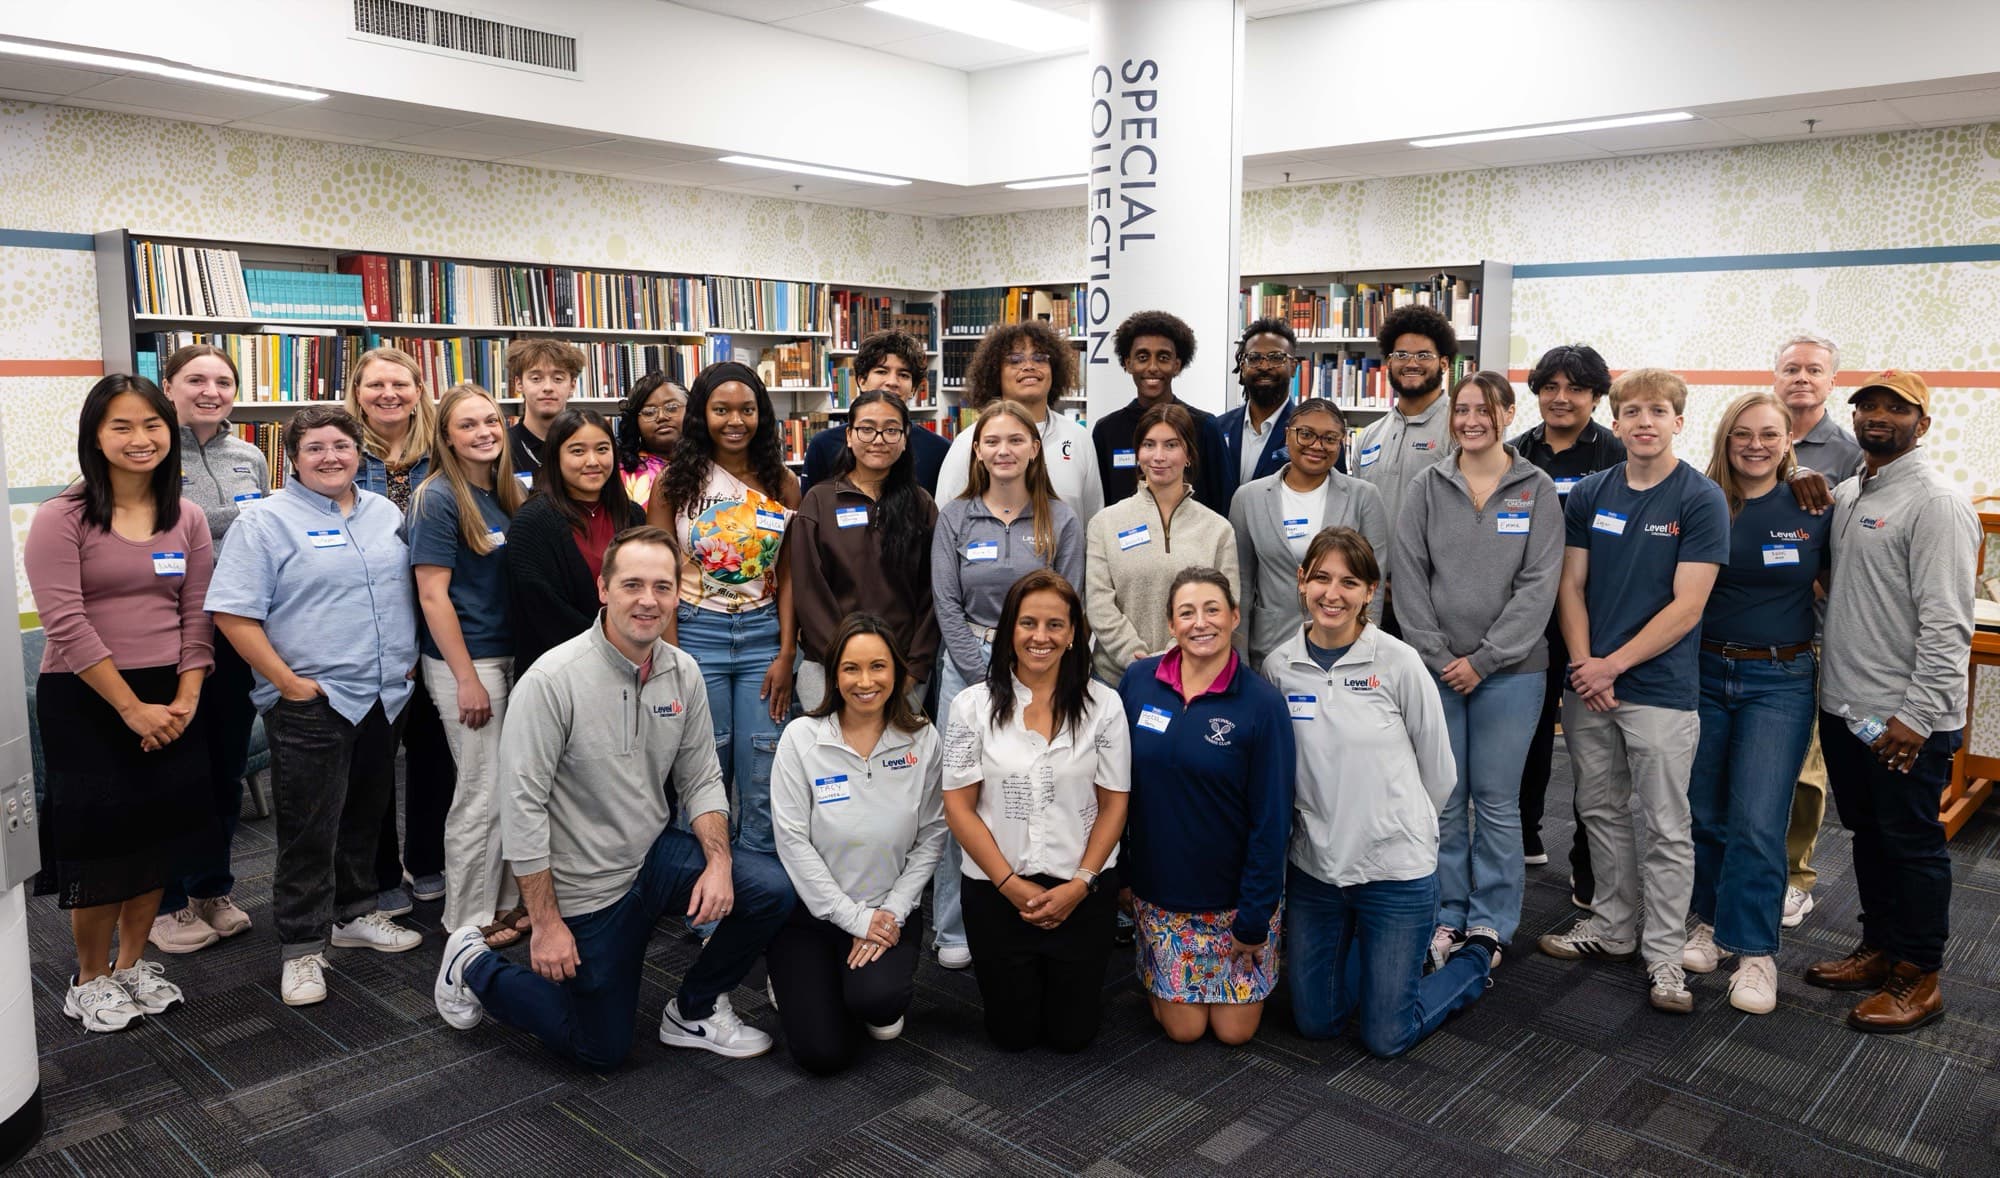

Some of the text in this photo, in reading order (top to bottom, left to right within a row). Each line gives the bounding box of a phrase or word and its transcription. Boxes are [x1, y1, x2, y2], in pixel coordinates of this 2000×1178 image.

[1119, 58, 1159, 252] SPECIAL
[1089, 64, 1113, 365] COLLECTION
[1645, 523, 1668, 533] Level
[1770, 528, 1809, 541] Level Up
[1344, 674, 1381, 689] Level Up
[882, 751, 918, 768] Level Up
